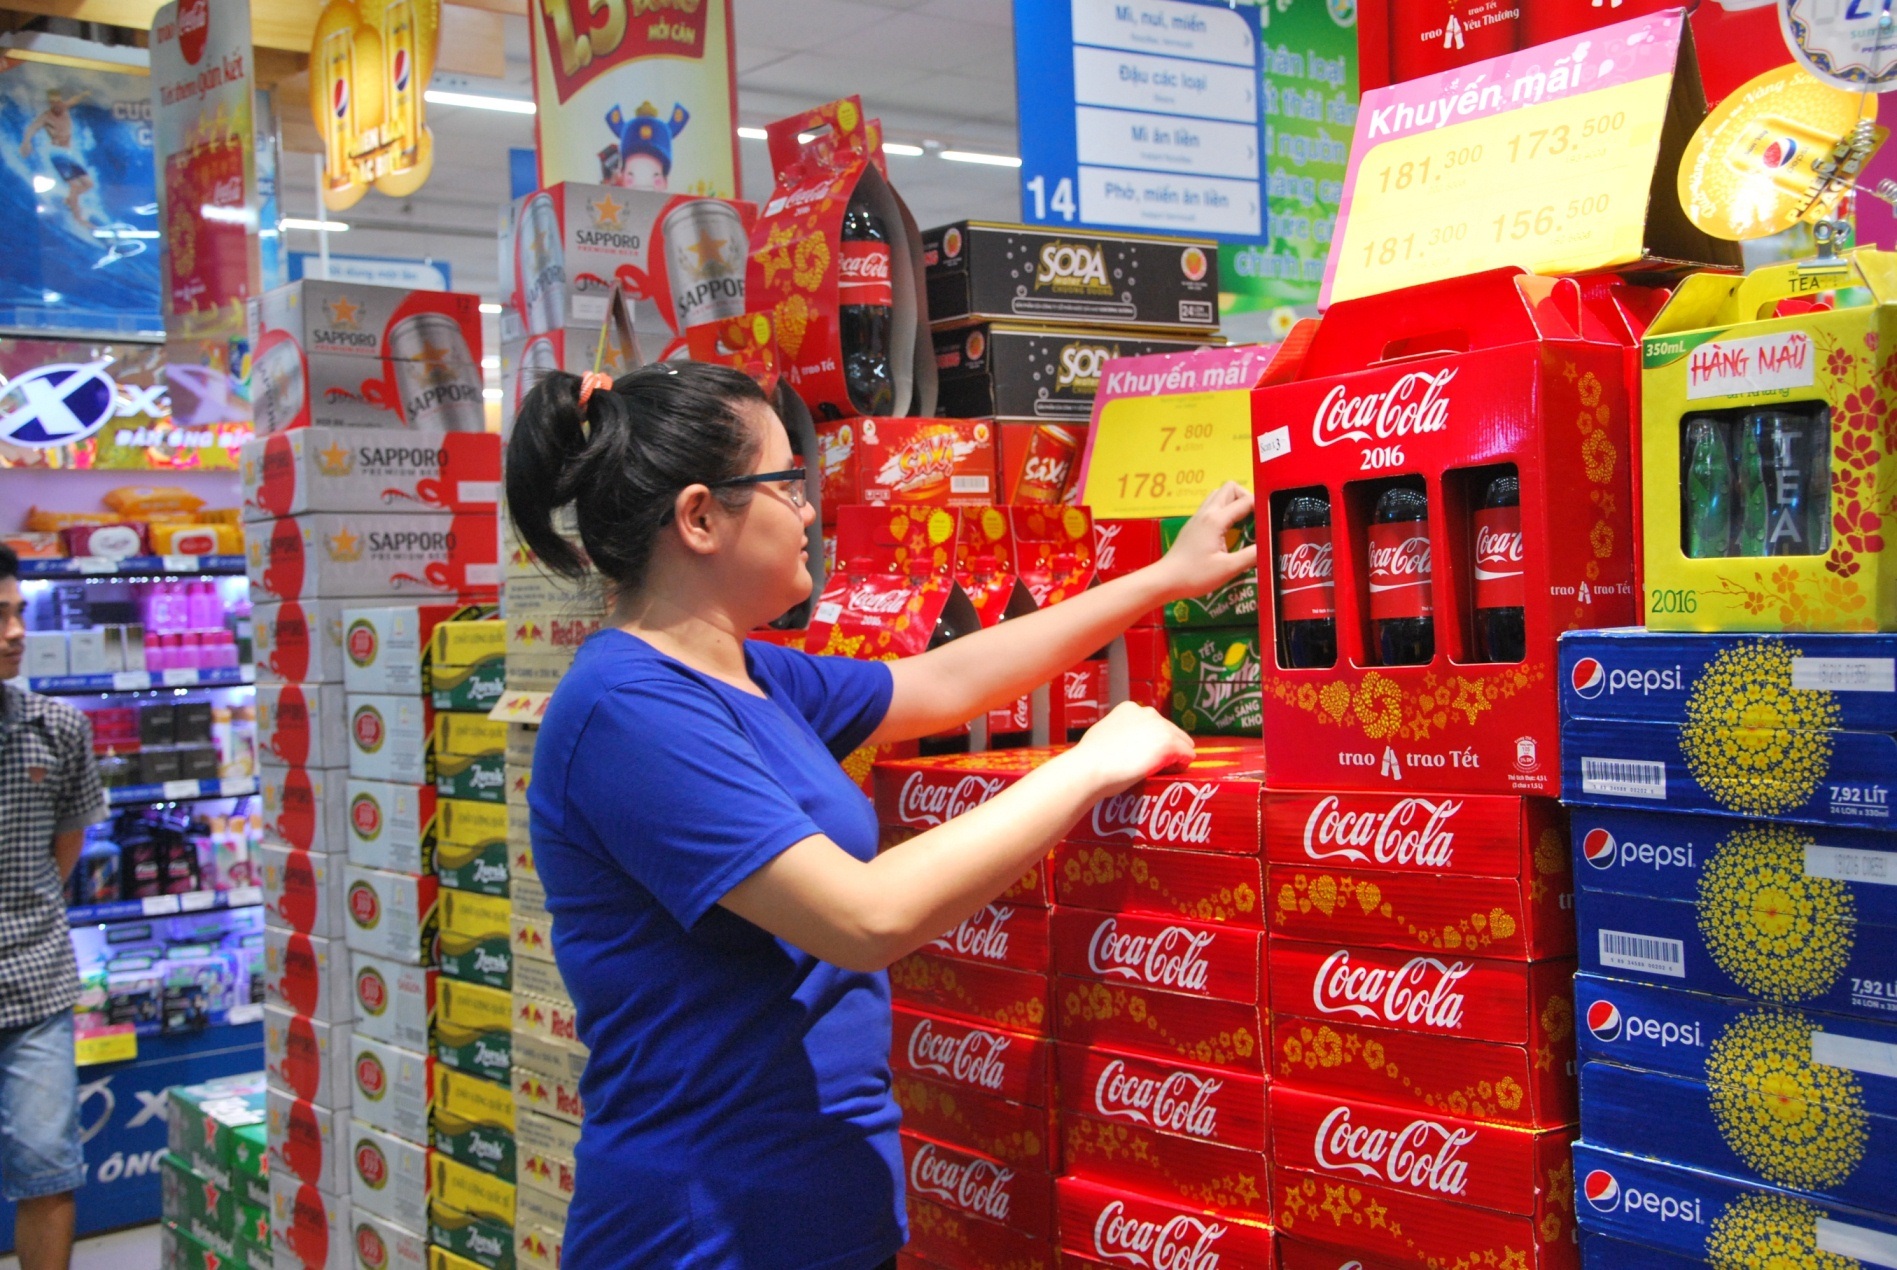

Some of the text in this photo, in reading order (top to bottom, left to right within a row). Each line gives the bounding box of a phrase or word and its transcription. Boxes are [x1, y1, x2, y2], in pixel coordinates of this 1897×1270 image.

[1420, 28, 1442, 41] trao
[1463, 7, 1520, 32] Yêu Thương
[1262, 42, 1304, 77] hân
[1368, 54, 1583, 139] Khuyến mãi
[1026, 174, 1077, 222] 14
[1267, 168, 1343, 208] âng ca
[575, 229, 641, 250] SAPPORO
[1037, 245, 1108, 286] SODA
[1788, 279, 1820, 293] TEA
[314, 330, 376, 348] SAPPORO
[1645, 339, 1687, 357] 350mL
[1059, 347, 1120, 385] SOD
[1105, 358, 1250, 396] Khuyến mãi
[1690, 344, 1750, 386] HÀNG
[1312, 366, 1459, 447] Coca-Cola
[358, 447, 450, 468] SAPPORO
[1359, 448, 1405, 471] 2016
[368, 532, 457, 552] SAPPORO
[1476, 525, 1524, 564] Coca-C
[1280, 542, 1333, 580] ca-Cola
[1550, 580, 1632, 596] trao trao Tết
[1651, 589, 1697, 614] 2016
[1234, 600, 1258, 616] KHO
[1202, 656, 1260, 710] Sprite
[1609, 664, 1682, 696] pepsi
[1241, 714, 1263, 729] KHO
[1338, 745, 1480, 769] trao trao Tết
[898, 770, 1006, 826] Coca-C
[1091, 780, 1220, 845] Coca-Cola
[1829, 784, 1888, 804] 7,92 LÍT
[1830, 806, 1841, 814] 24
[1303, 794, 1464, 867] Coca-Cola
[1620, 842, 1694, 871] pepsi
[933, 902, 1014, 960] a-Cola
[1087, 916, 1217, 993] Coca-Cola
[1312, 948, 1475, 1029] Coca-Cola
[1850, 977, 1897, 998] 7,92 LÍ
[1626, 1015, 1702, 1048] pepsi
[907, 1017, 1012, 1091] Coca-Cola
[1095, 1058, 1224, 1137] Coca-Cola
[1313, 1105, 1478, 1196] Coca-Cola
[910, 1141, 1015, 1221] Coca-Cola
[1624, 1187, 1703, 1224] pepsi
[1093, 1199, 1228, 1270] Coca-Cola
